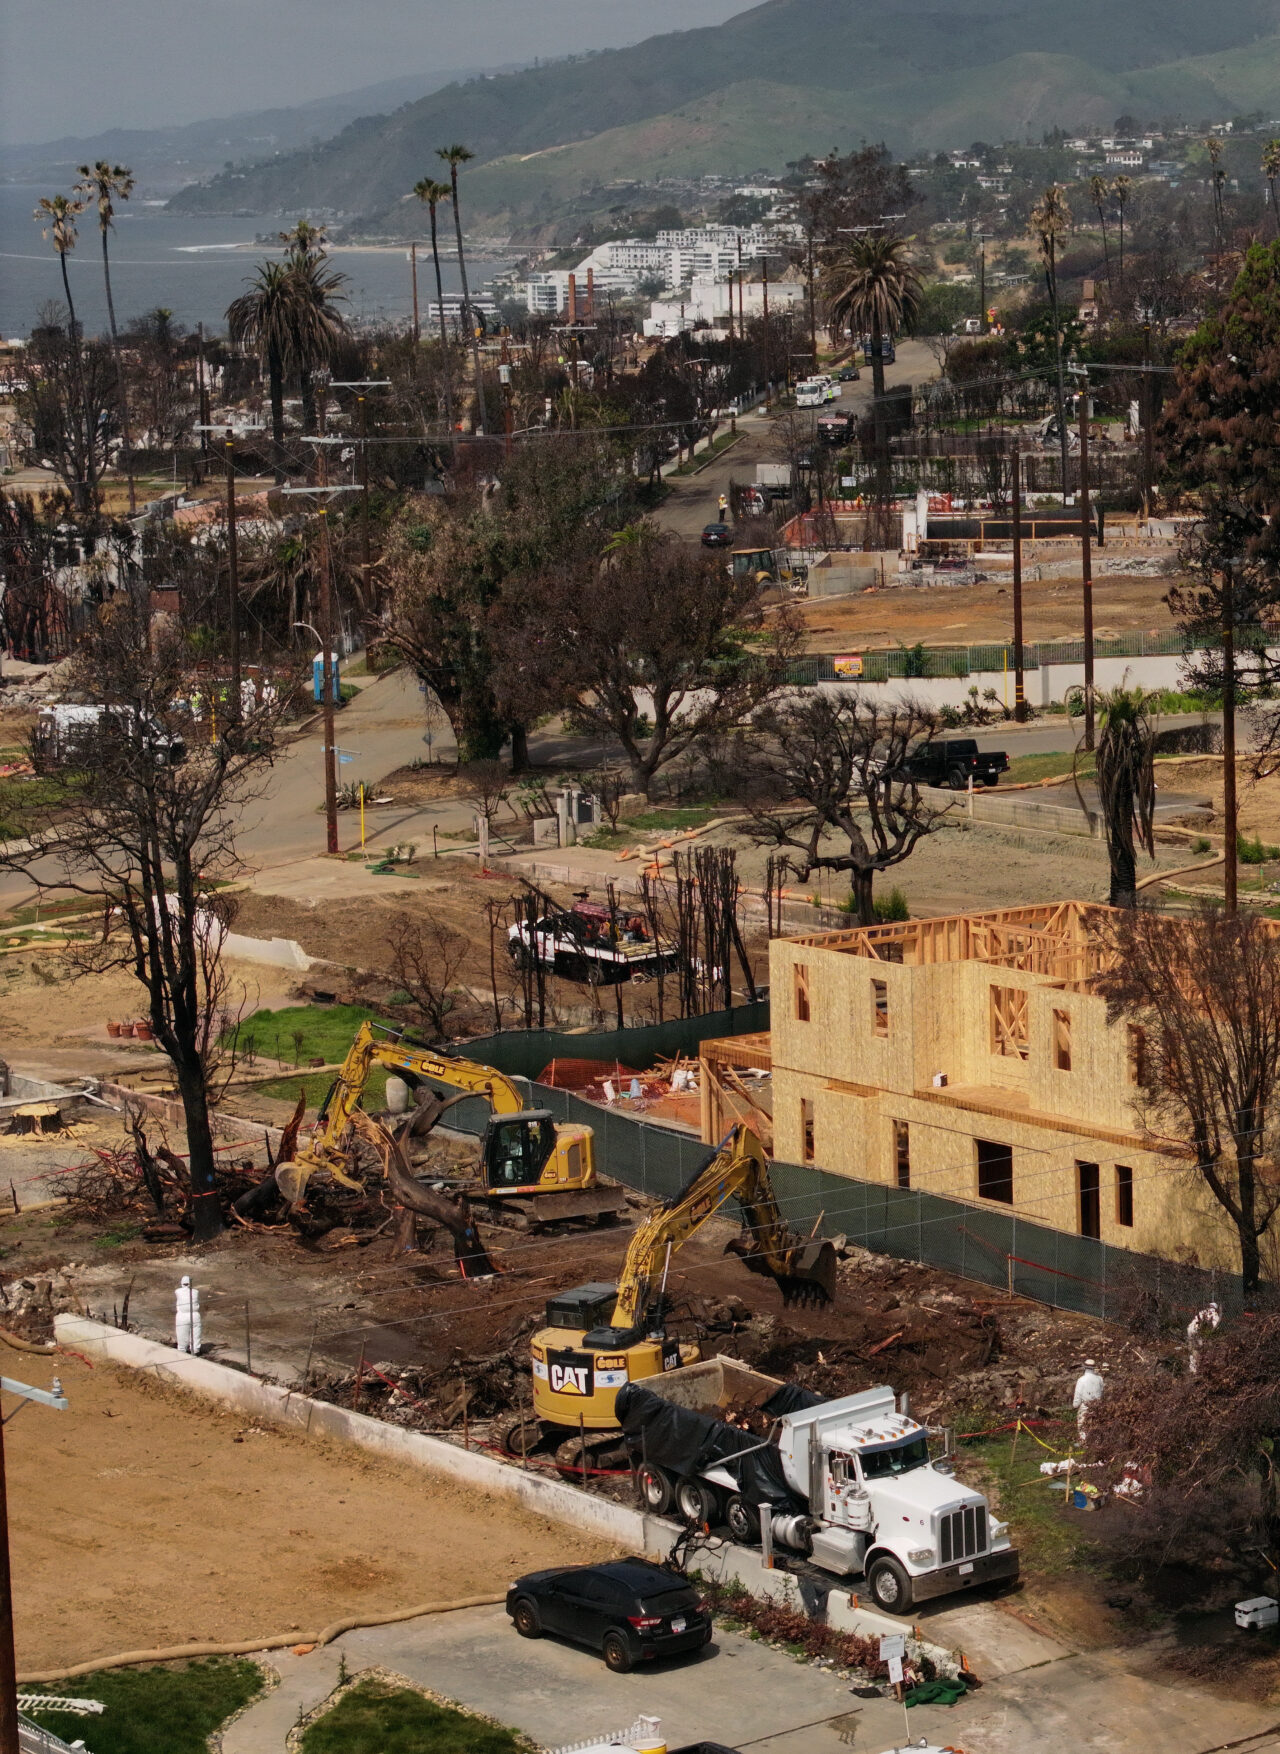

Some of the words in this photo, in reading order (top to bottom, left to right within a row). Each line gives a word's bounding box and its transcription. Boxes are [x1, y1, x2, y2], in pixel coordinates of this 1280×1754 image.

[597, 1358, 626, 1369] COLE
[664, 1354, 677, 1371] CAT
[551, 1365, 588, 1395] CAT
